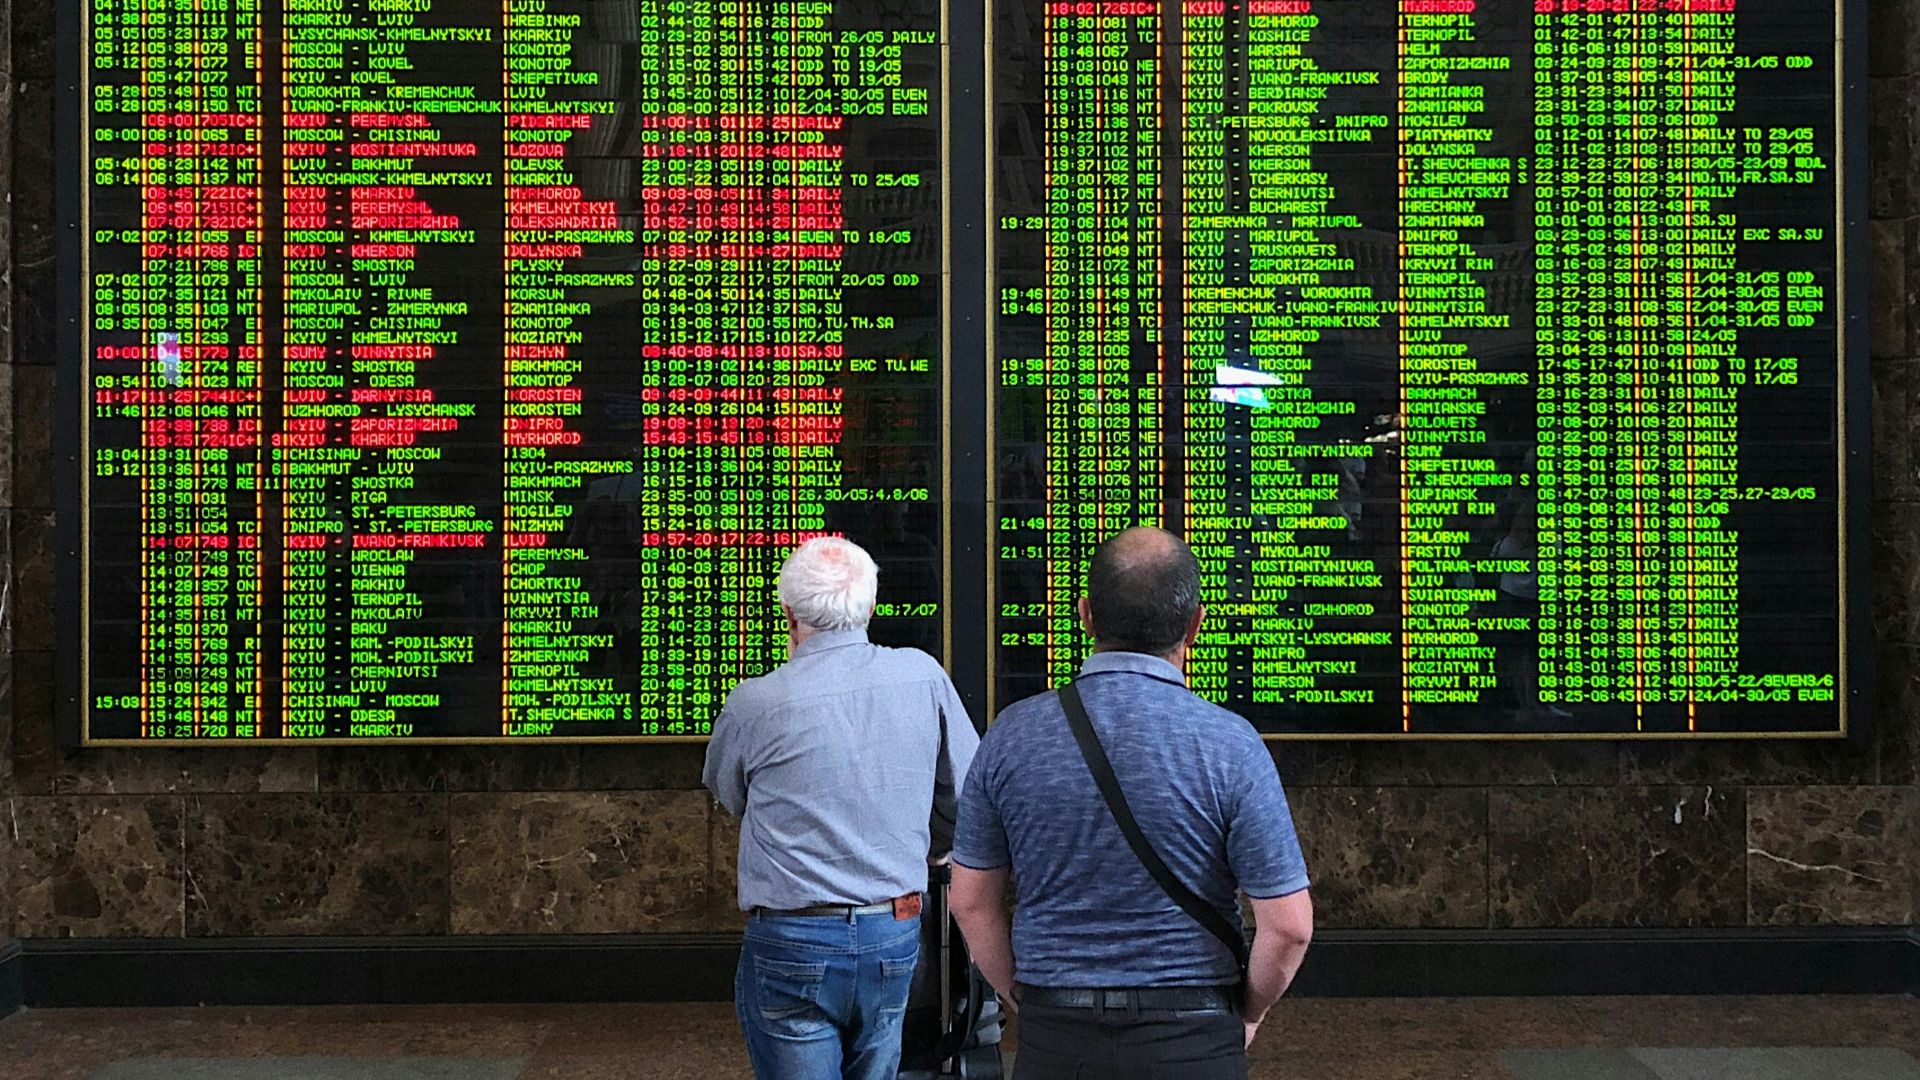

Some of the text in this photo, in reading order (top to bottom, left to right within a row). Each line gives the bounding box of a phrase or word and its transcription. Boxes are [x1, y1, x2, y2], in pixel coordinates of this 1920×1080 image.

[203, 13, 226, 25] 111
[236, 13, 254, 25] NT
[289, 14, 351, 25] KHARKIV
[378, 14, 413, 25] LVIV
[510, 15, 580, 26] HREBINKA
[797, 16, 824, 28] ODD
[1249, 14, 1683, 28] UZHHOROD TERNOPIL 10:40
[95, 27, 139, 39] 05:05
[797, 31, 832, 42] FROM
[893, 32, 935, 43] DAILY
[1188, 43, 1440, 57] KYIV WARSAW HELM
[289, 72, 395, 83] KYIV KOVEL
[1405, 72, 1449, 83] BRODY
[510, 87, 545, 98] LVIV
[1249, 86, 1484, 99] BERDIANSK ZNAMIANKA
[1137, 102, 1153, 113] NT
[1336, 116, 1388, 127] DNIPRO
[290, 129, 440, 141] MOSCOW CHISINAU
[1249, 130, 1371, 142] NOVOOLEKSIIVKA
[1692, 128, 1735, 140] DAILY
[1744, 128, 1761, 139] TO
[511, 159, 563, 170] OLEVSK
[799, 174, 841, 186] DAILY
[851, 174, 867, 186] TO
[876, 174, 919, 186] 25/05
[1250, 173, 1327, 184] TCHERKASY
[1189, 187, 1508, 199] KYIV CHERNIVTSI KHMELNYTSKYI
[1250, 200, 1710, 213] BUCHAREST FR
[1105, 217, 1128, 228] 104
[1137, 217, 1154, 228] NT
[96, 231, 140, 242] 07:02
[147, 231, 193, 243] 07:12
[290, 231, 343, 242] MOSCOW
[370, 231, 474, 242] KHMELNYTSKYI
[799, 231, 833, 243] EVEN
[842, 231, 859, 243] TO
[1250, 244, 1336, 256] TRUSKAVETS
[353, 260, 790, 271] SHOSTKA 11:27
[1250, 259, 1354, 270] ZAPORIZHZHIA
[288, 289, 361, 300] MYKOLAIV
[388, 288, 432, 300] RIVNE
[511, 289, 564, 300] KORSUN
[1190, 287, 1485, 299] KREMENCHUK VOROKHTA VINNYTSIA
[290, 303, 361, 314] MARIUPOL
[388, 303, 467, 314] ZHMERYNKA
[511, 303, 590, 314] ZNAMIANKA
[290, 331, 842, 344] KYIV KHMELNYTSKYI 15:10 27/05
[288, 345, 435, 359] SUMY VINNYTSIA
[1190, 344, 1302, 356] KYIV MOSCOW
[1407, 359, 1476, 370] KOROSTEN
[1693, 359, 1719, 370] ODD
[1728, 358, 1745, 369] TO
[1755, 358, 1797, 370] 17/05
[288, 405, 360, 416] UZHHOROD
[387, 404, 475, 416] LYSYCHANSK
[1407, 431, 1485, 442] VINNYTSIA
[290, 446, 833, 460] CHISINAU MOSCOW EVEN
[1407, 445, 1442, 457] SUMY
[290, 463, 351, 474] BAKHMUT
[378, 463, 413, 474] LVIV
[1139, 460, 1156, 471] NT
[352, 492, 386, 503] RIGA
[510, 491, 553, 502] MINSK
[1251, 488, 1338, 500] LYSYCHANSK
[1408, 488, 1477, 500] KUPIANSK
[511, 505, 572, 517] MOGILEV
[1191, 517, 1252, 529] KHARKIV
[1277, 517, 1347, 529] UZHHOROD
[1191, 531, 1470, 543] KYIV MINSK ZHLOBYN
[290, 549, 589, 562] KYIV WROCLAW PEREMYSHL
[1408, 546, 1460, 557] FASTIV
[352, 563, 545, 576] VIENNA CHOP
[352, 578, 580, 590] RAKHIV CHORTKIV
[1408, 589, 1496, 601] SVIATOSHYN
[352, 608, 422, 619] MYKOLAIV
[351, 621, 571, 634] BAKU KHARKIV
[1253, 647, 1305, 659] DNIPRO
[289, 666, 437, 678] KYIV CHERNIVTSI
[1192, 676, 1496, 688] KYIV KHERSON KRYVYI RIH
[1409, 691, 1479, 702] HRECHANY
[1798, 689, 1833, 701] EVEN
[150, 696, 191, 708] 15:24
[351, 723, 553, 736] KHARKIV LUBNY
